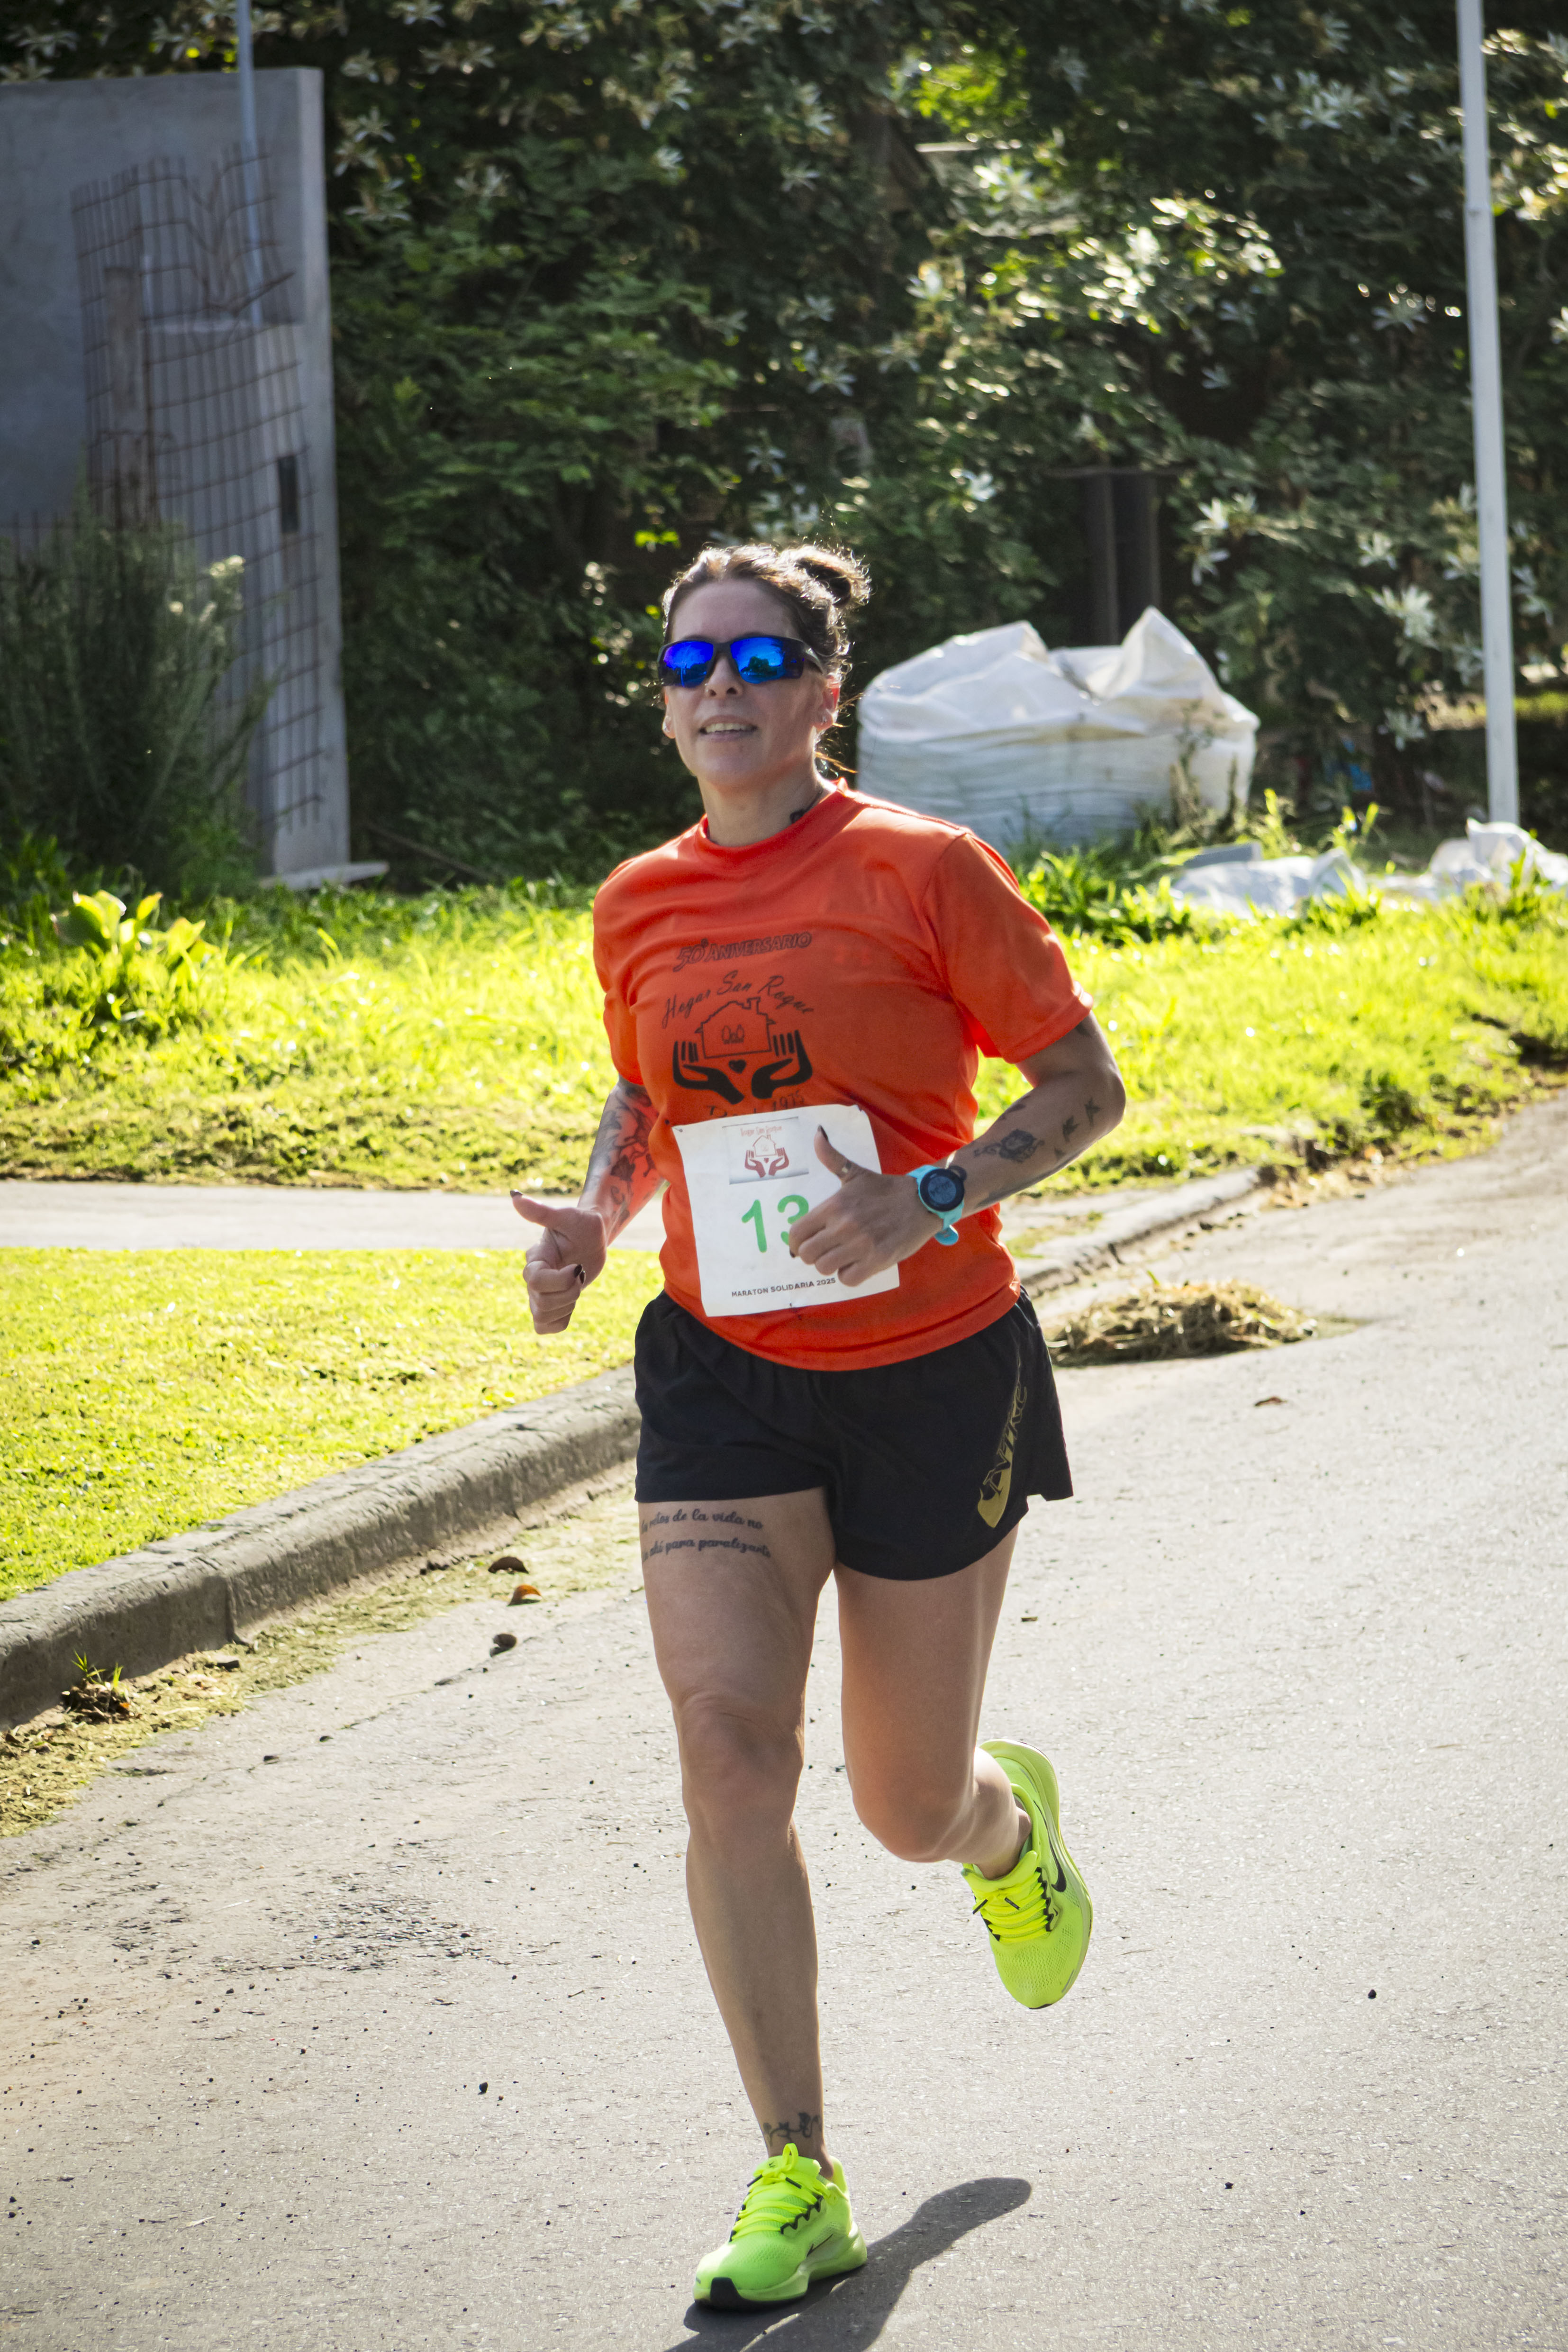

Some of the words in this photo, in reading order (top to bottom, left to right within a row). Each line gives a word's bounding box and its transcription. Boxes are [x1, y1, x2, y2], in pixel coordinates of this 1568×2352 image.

[662, 990, 711, 1029] Hogar
[717, 970, 752, 996] San
[757, 975, 814, 1015] Roque
[731, 1288, 769, 1298] MARATON
[770, 1280, 815, 1293] SOLIDARIA
[816, 1277, 836, 1287] 2025
[692, 1508, 708, 1521] la
[712, 1511, 745, 1525] vida
